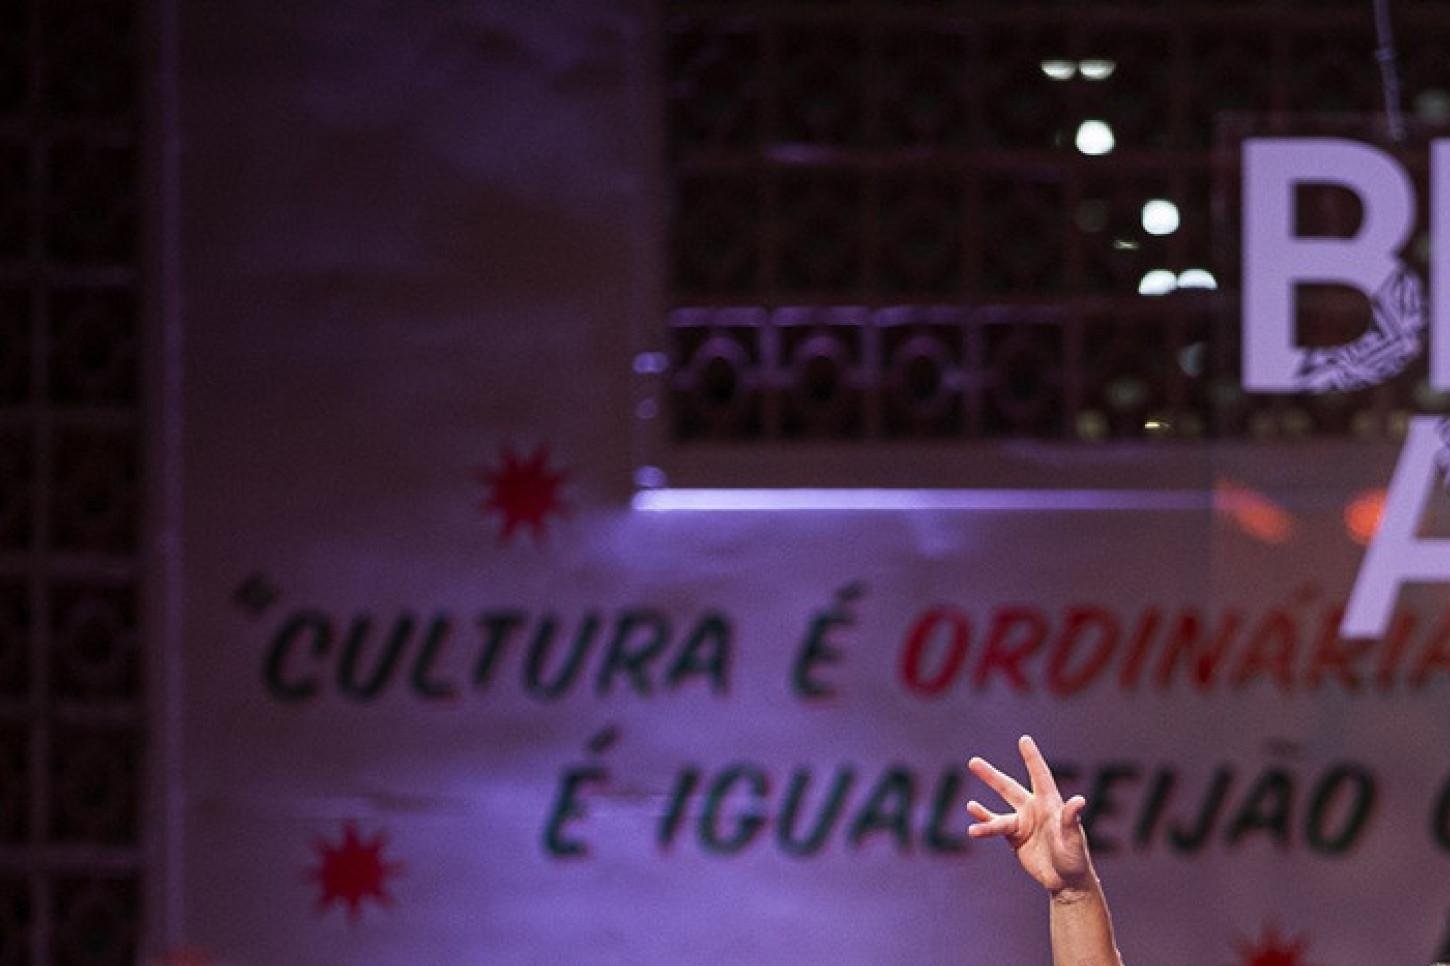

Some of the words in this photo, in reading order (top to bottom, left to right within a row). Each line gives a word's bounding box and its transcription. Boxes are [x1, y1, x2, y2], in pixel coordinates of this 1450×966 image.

[790, 580, 869, 698] É
[542, 726, 618, 860] É
[653, 762, 972, 858] IGUAL
